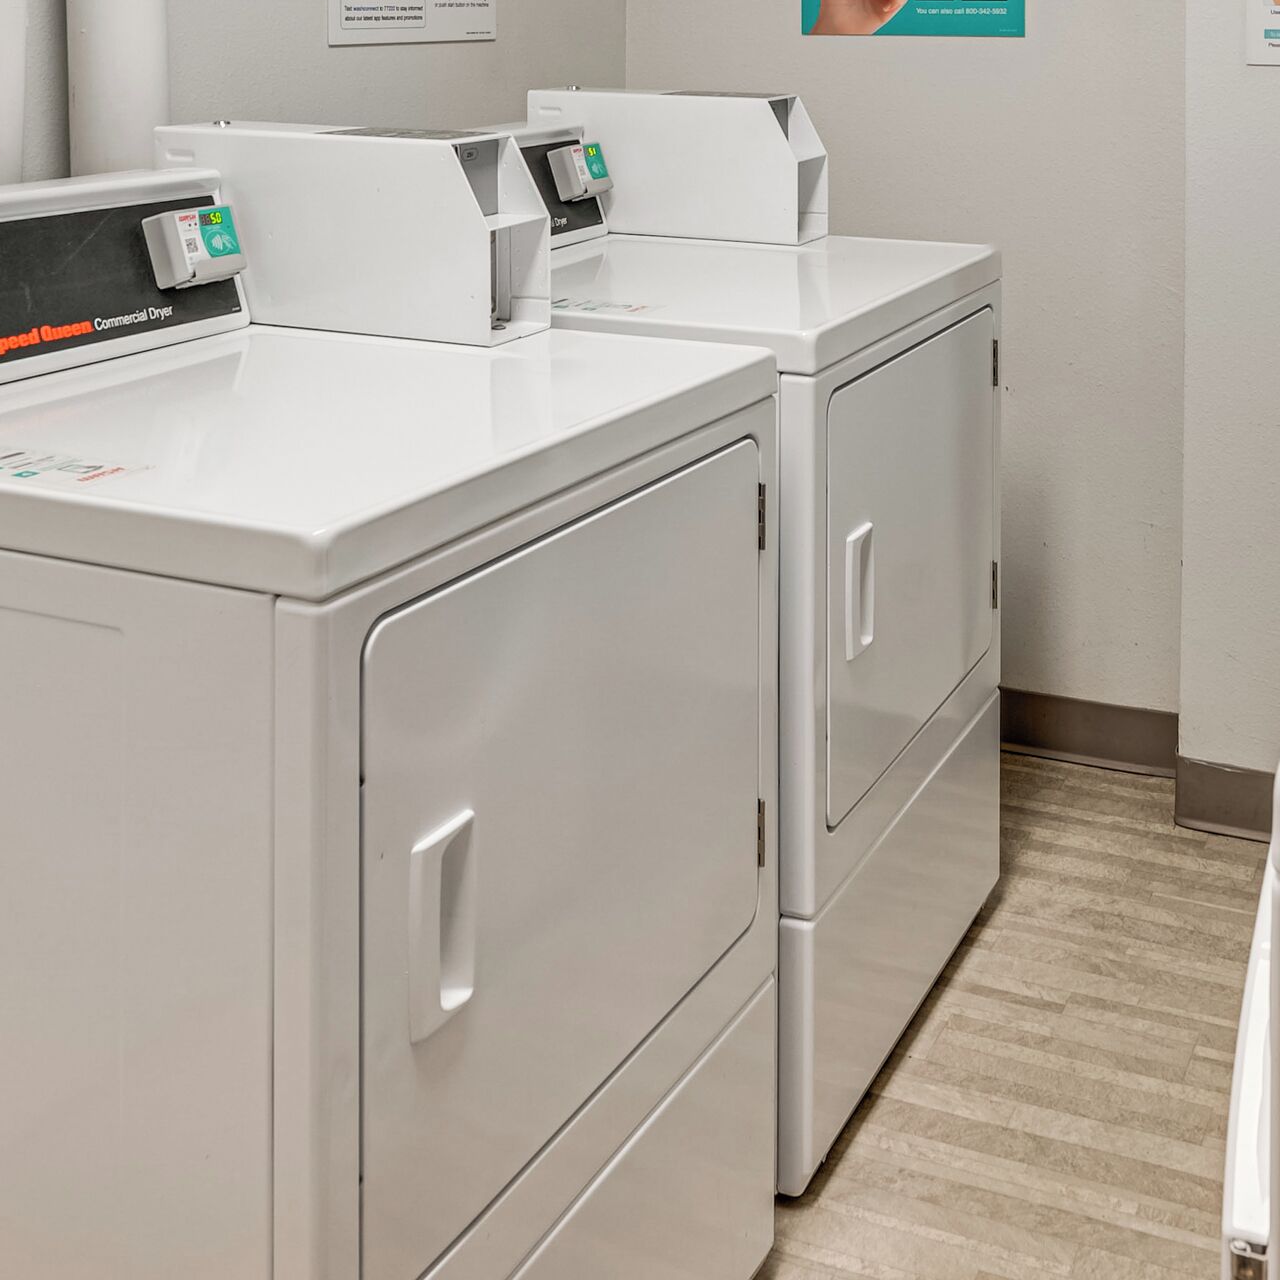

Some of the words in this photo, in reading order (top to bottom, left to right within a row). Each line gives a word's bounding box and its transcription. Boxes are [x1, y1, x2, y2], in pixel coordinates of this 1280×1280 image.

[40, 320, 94, 343] Queen
[94, 308, 148, 331] Commercial
[148, 305, 173, 322] Dryer
